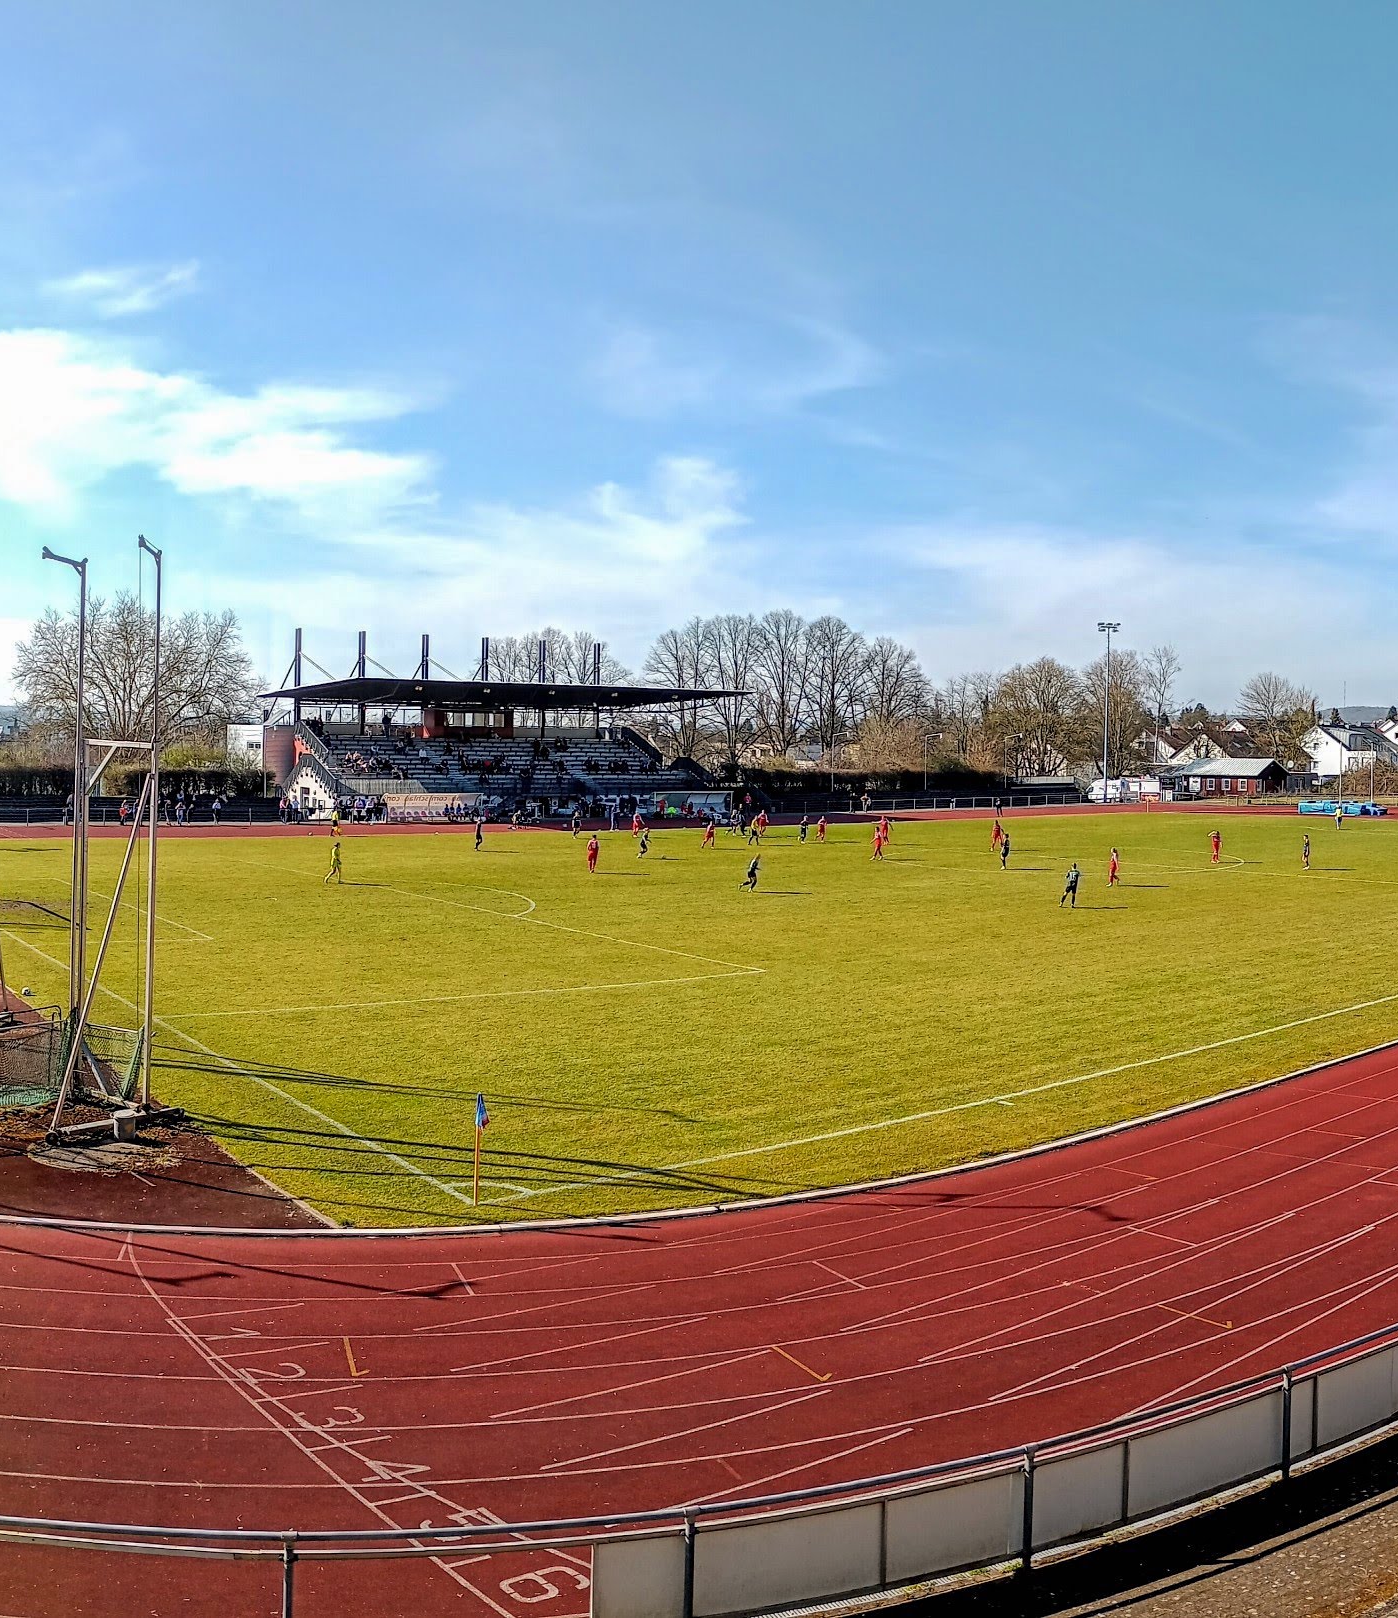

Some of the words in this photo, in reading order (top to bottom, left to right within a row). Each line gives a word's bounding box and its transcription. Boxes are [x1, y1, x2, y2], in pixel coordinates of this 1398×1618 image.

[204, 1326, 261, 1342] 1
[237, 1362, 307, 1385] 2
[293, 1406, 365, 1431] 3
[362, 1459, 432, 1483] 4
[499, 1565, 592, 1603] 6
